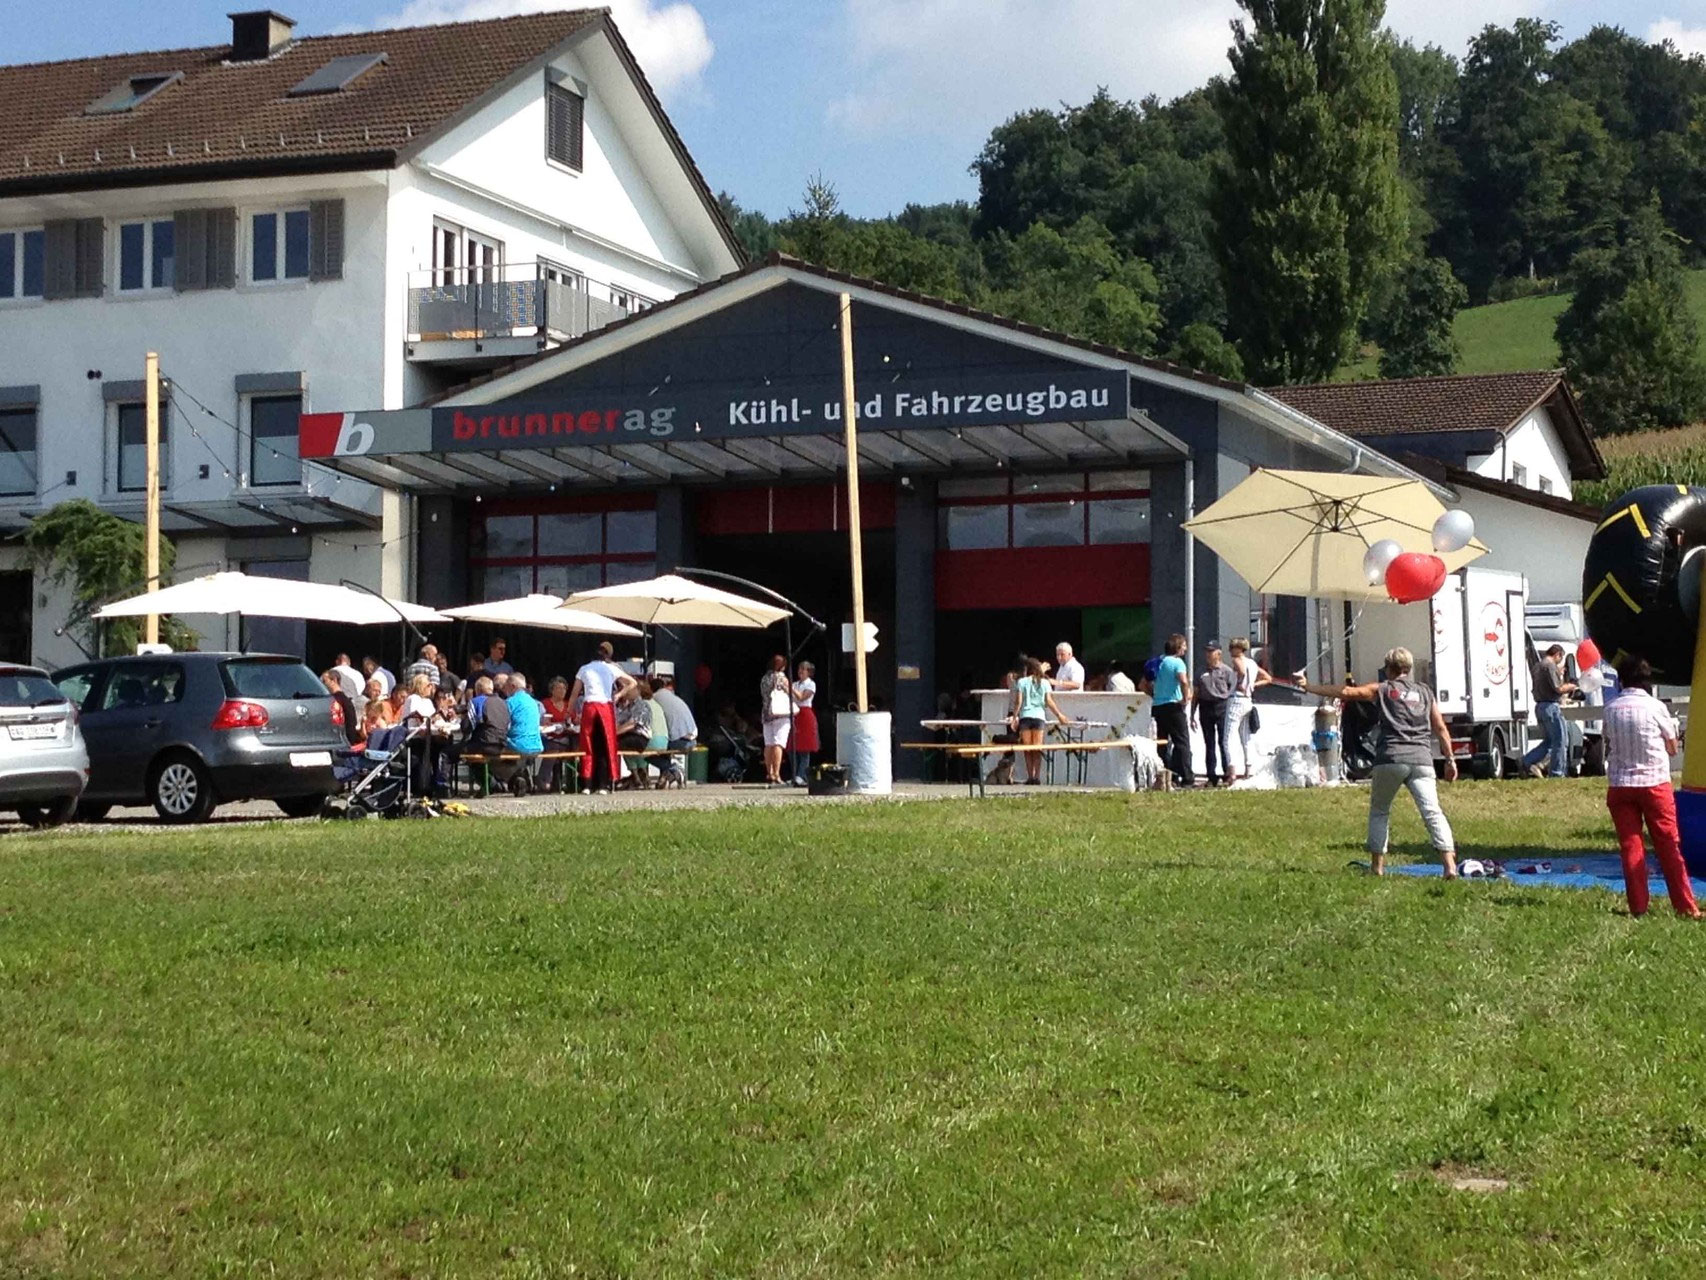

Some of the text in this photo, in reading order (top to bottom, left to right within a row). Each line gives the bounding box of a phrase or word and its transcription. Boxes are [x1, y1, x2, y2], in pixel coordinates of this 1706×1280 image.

[729, 398, 811, 425] Kühl-
[895, 384, 1109, 417] Fahrzeugbau
[333, 412, 376, 456] b
